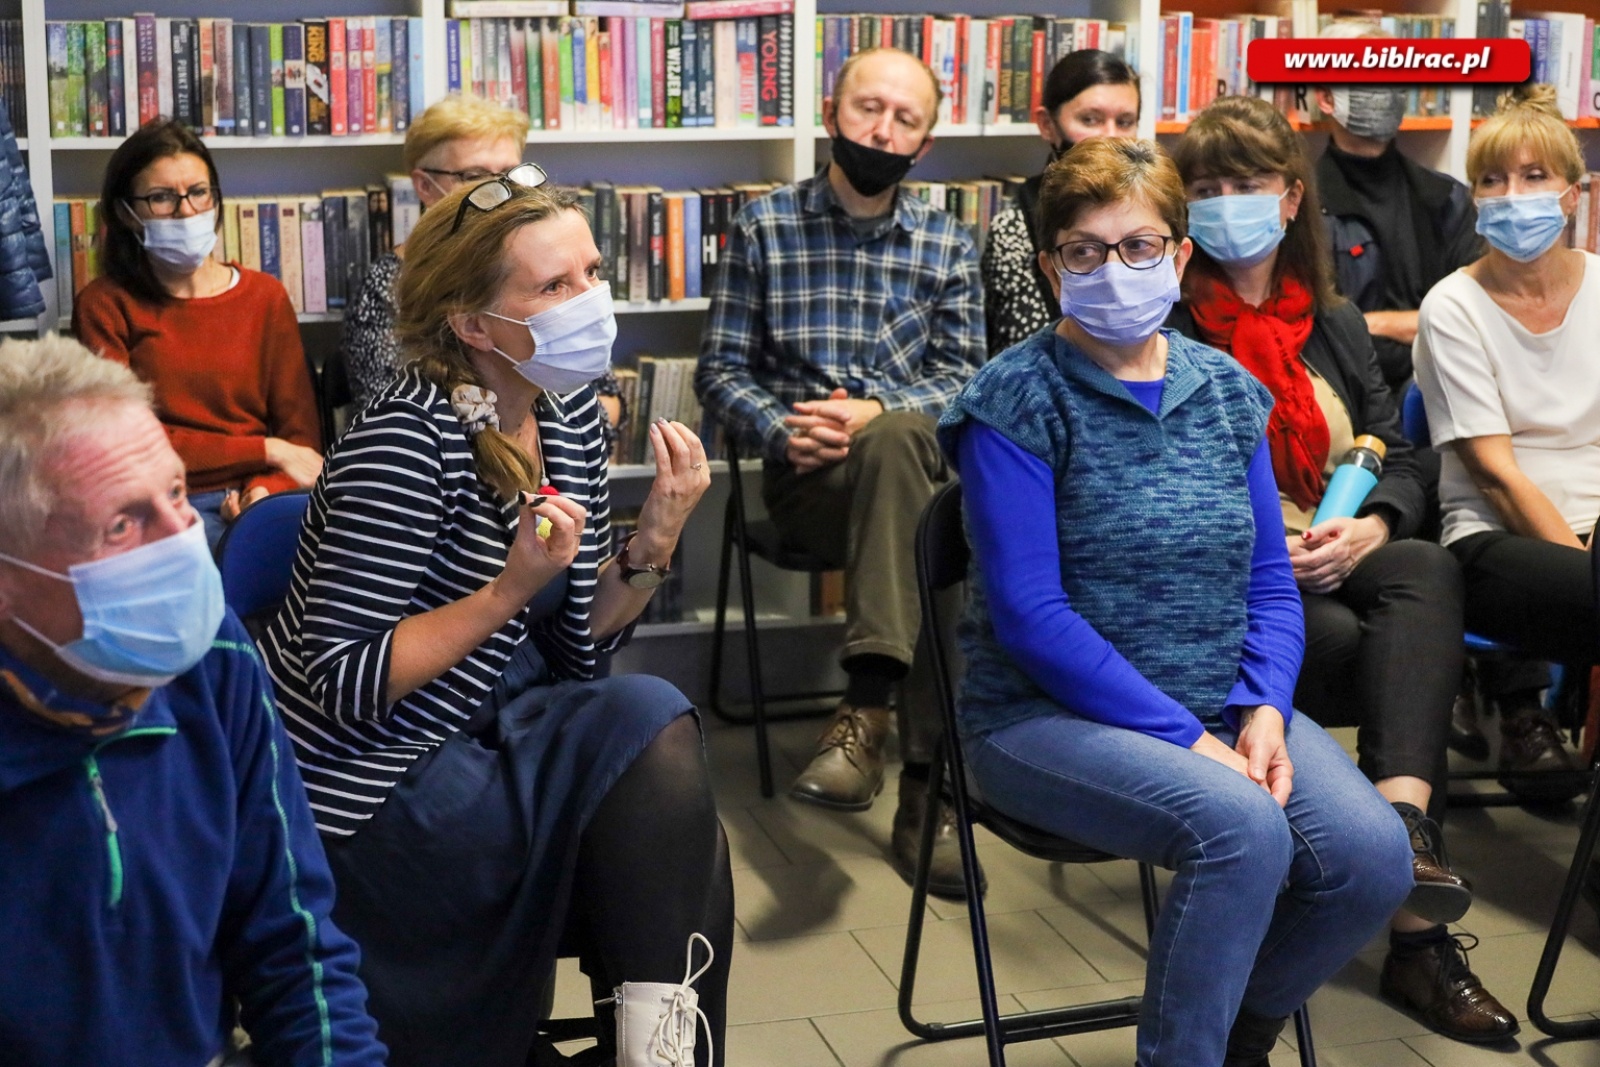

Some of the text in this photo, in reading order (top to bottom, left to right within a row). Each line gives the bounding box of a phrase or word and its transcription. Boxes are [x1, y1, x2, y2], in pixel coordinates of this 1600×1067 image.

[307, 26, 319, 62] KING
[177, 59, 188, 89] PUNKT
[667, 47, 681, 97] WIZJER
[761, 30, 778, 101] YOUNG
[178, 93, 189, 117] ZERO
